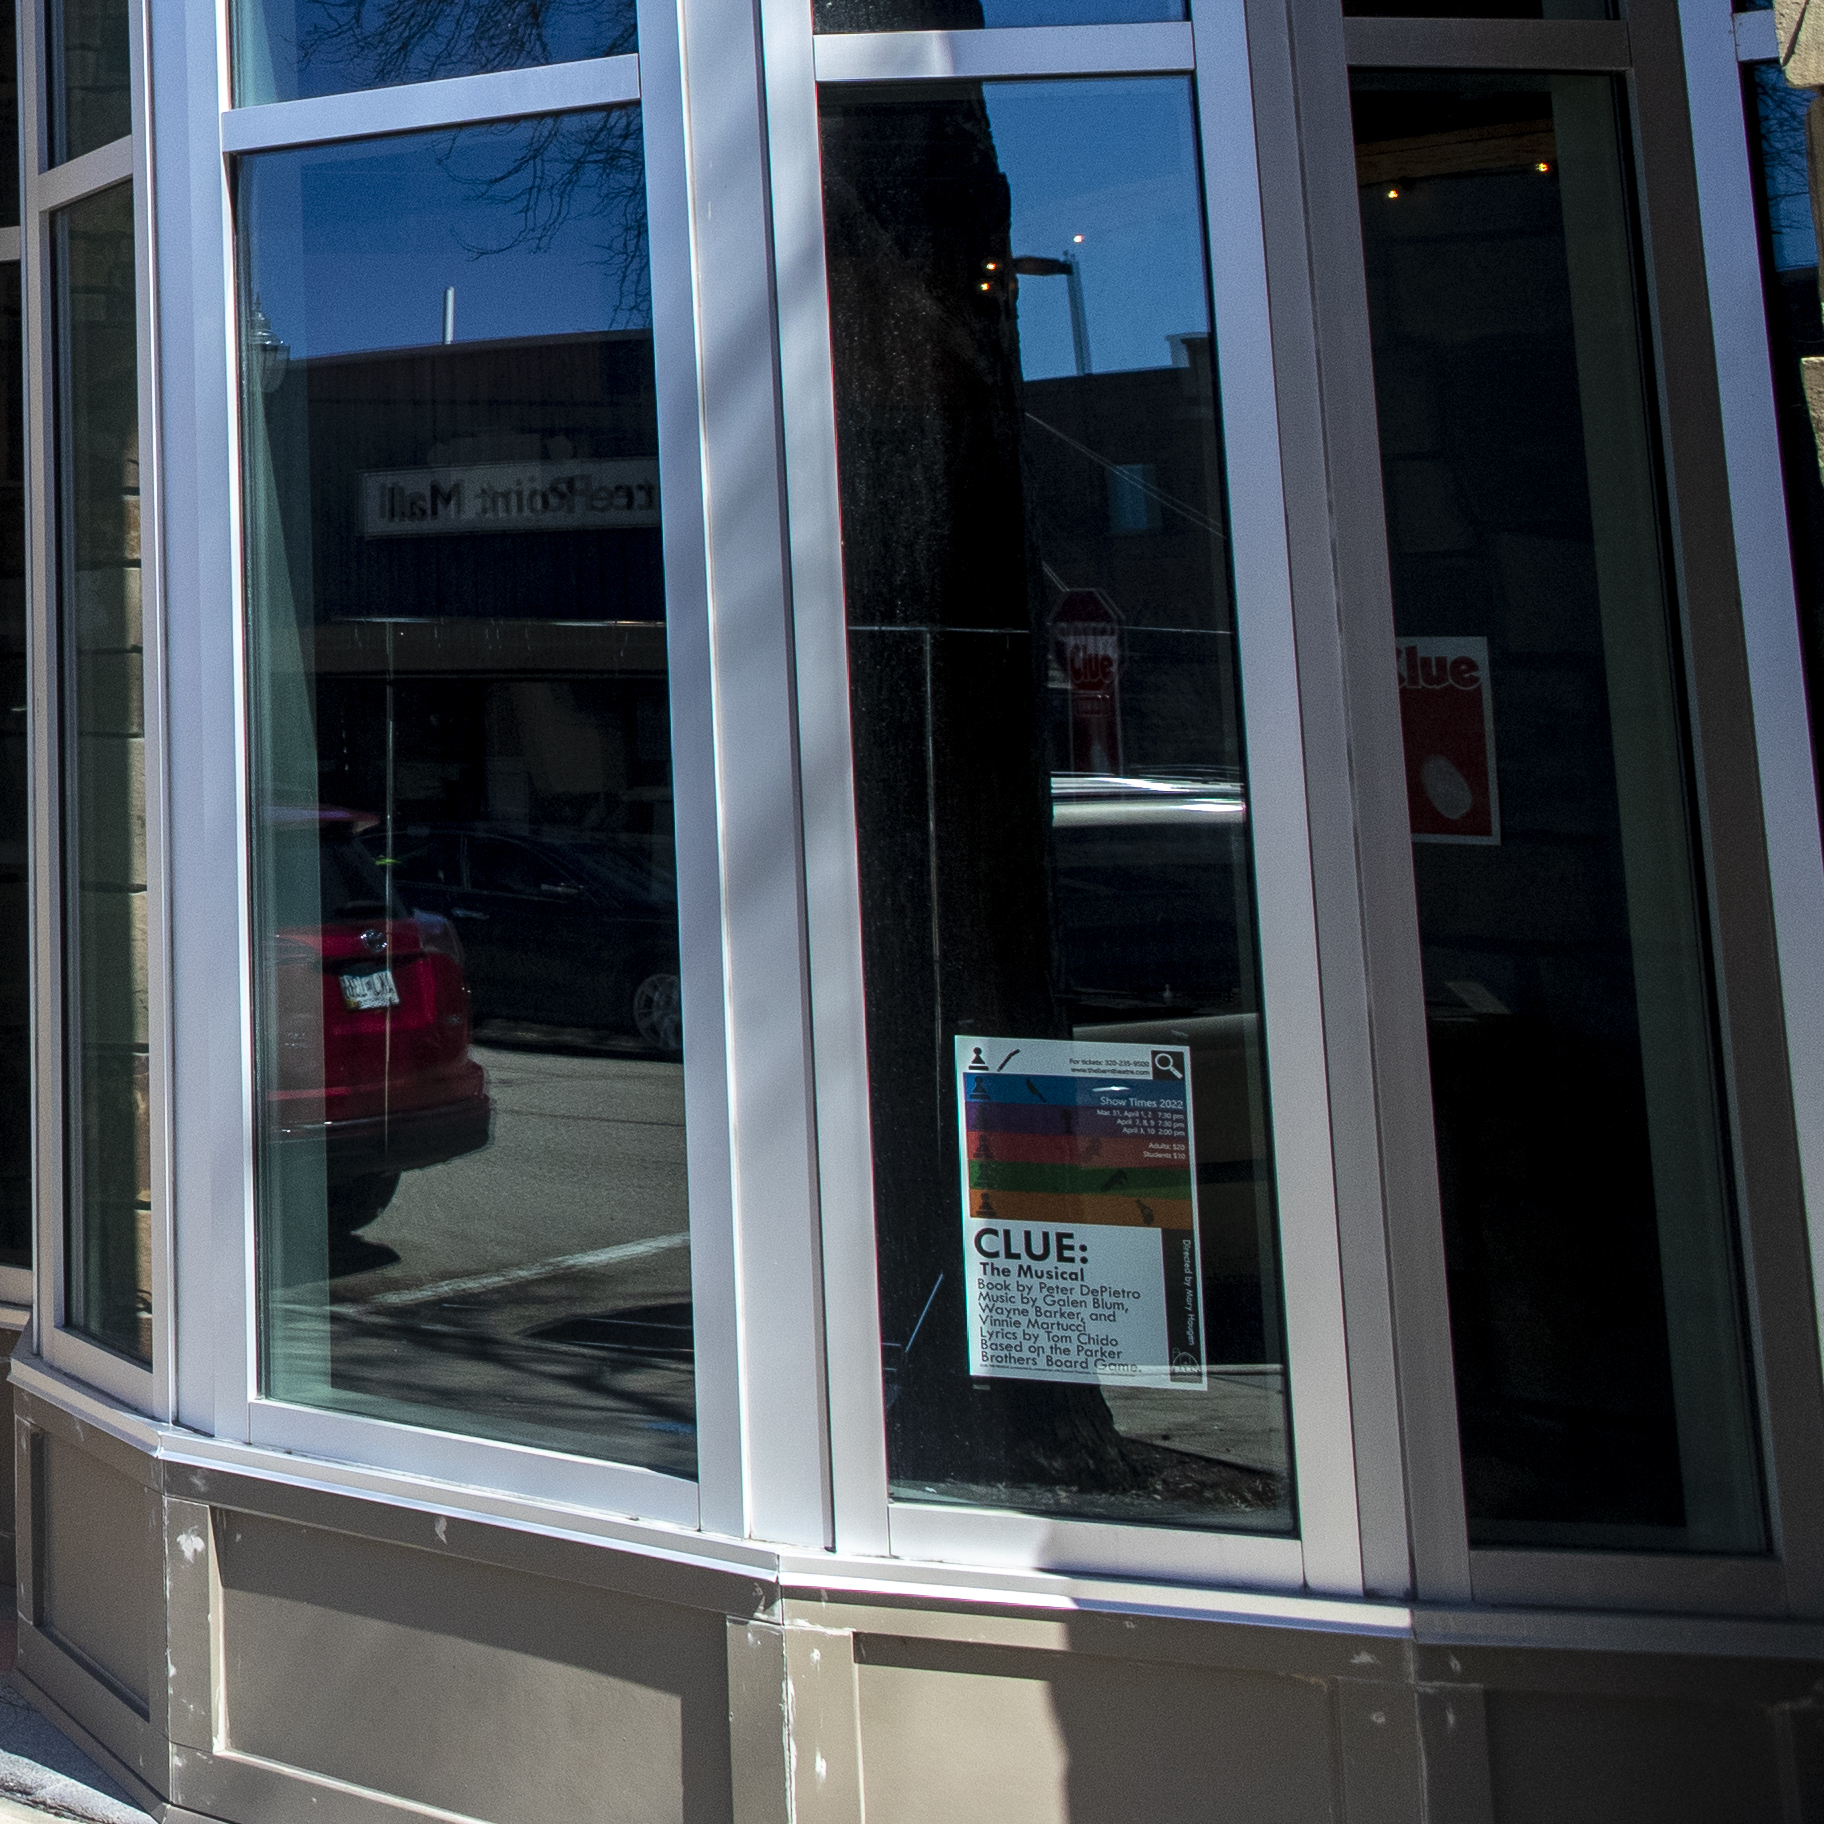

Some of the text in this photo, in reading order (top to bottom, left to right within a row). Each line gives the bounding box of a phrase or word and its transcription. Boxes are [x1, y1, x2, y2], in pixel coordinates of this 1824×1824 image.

[1100, 1096, 1183, 1109] Show Times 2022
[1172, 1113, 1184, 1121] pm
[1173, 1121, 1185, 1129] pm
[974, 1227, 1090, 1264] CLUE:
[1182, 1239, 1193, 1274] Directed
[979, 1261, 1085, 1282] The Musical
[1183, 1276, 1194, 1287] by
[977, 1278, 1141, 1300] Book by Peter DePietro
[978, 1291, 1129, 1314] Music by Galen Blum,
[1184, 1288, 1195, 1312] Mary
[979, 1303, 1117, 1323] Wayne Barker, and
[979, 1314, 1086, 1333] Vinnie Martucci
[980, 1326, 1119, 1348] Lyrics by Tom Chido
[981, 1339, 1123, 1360] Based on the Parker
[1045, 1354, 1089, 1371] Board
[1094, 1357, 1142, 1374] Game.
